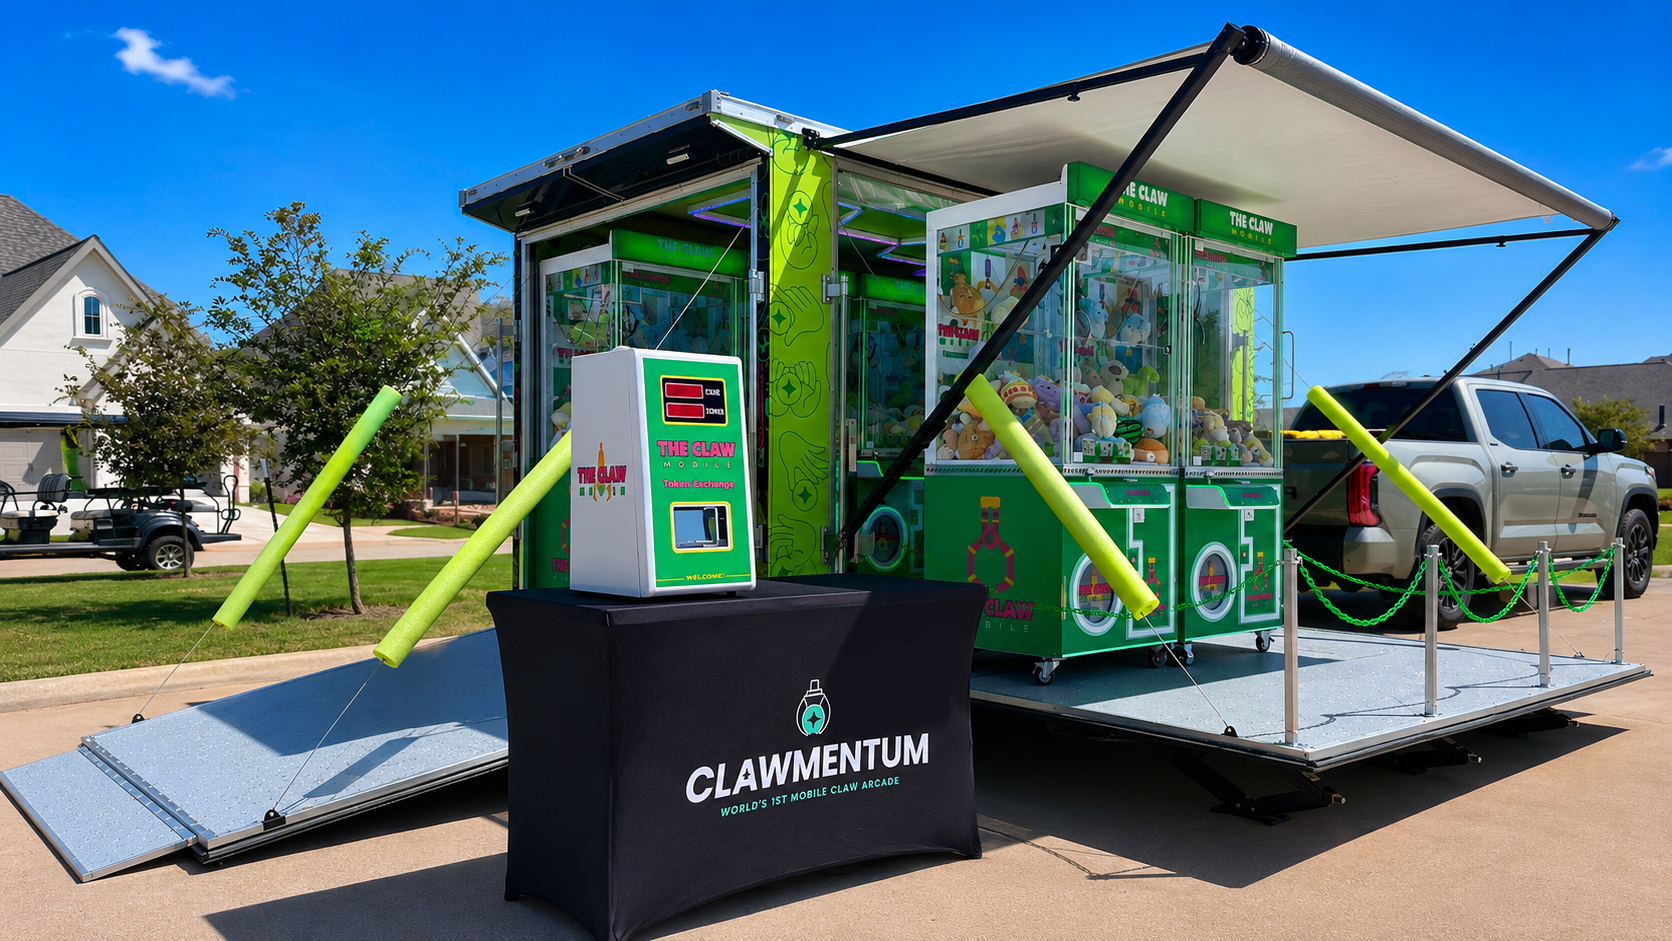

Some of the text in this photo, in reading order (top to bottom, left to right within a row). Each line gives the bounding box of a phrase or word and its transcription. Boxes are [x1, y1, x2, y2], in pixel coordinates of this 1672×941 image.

[1122, 181, 1169, 207] HE CLAW
[1229, 210, 1274, 236] THE CLAW
[1231, 228, 1272, 245] MOBILE
[657, 238, 713, 259] THE CLAW
[656, 440, 736, 458] THE CLAW
[577, 465, 627, 484] THE CLAW
[663, 461, 732, 469] MOBILE
[662, 479, 735, 490] Token Exchange
[551, 557, 569, 573] THE
[983, 598, 1035, 621] CLAW
[985, 620, 1030, 633] BILE
[685, 732, 930, 804] CLAWMENTUM
[720, 776, 900, 817] WORLD'S 1ST MOBILE CLAW ARCADE
